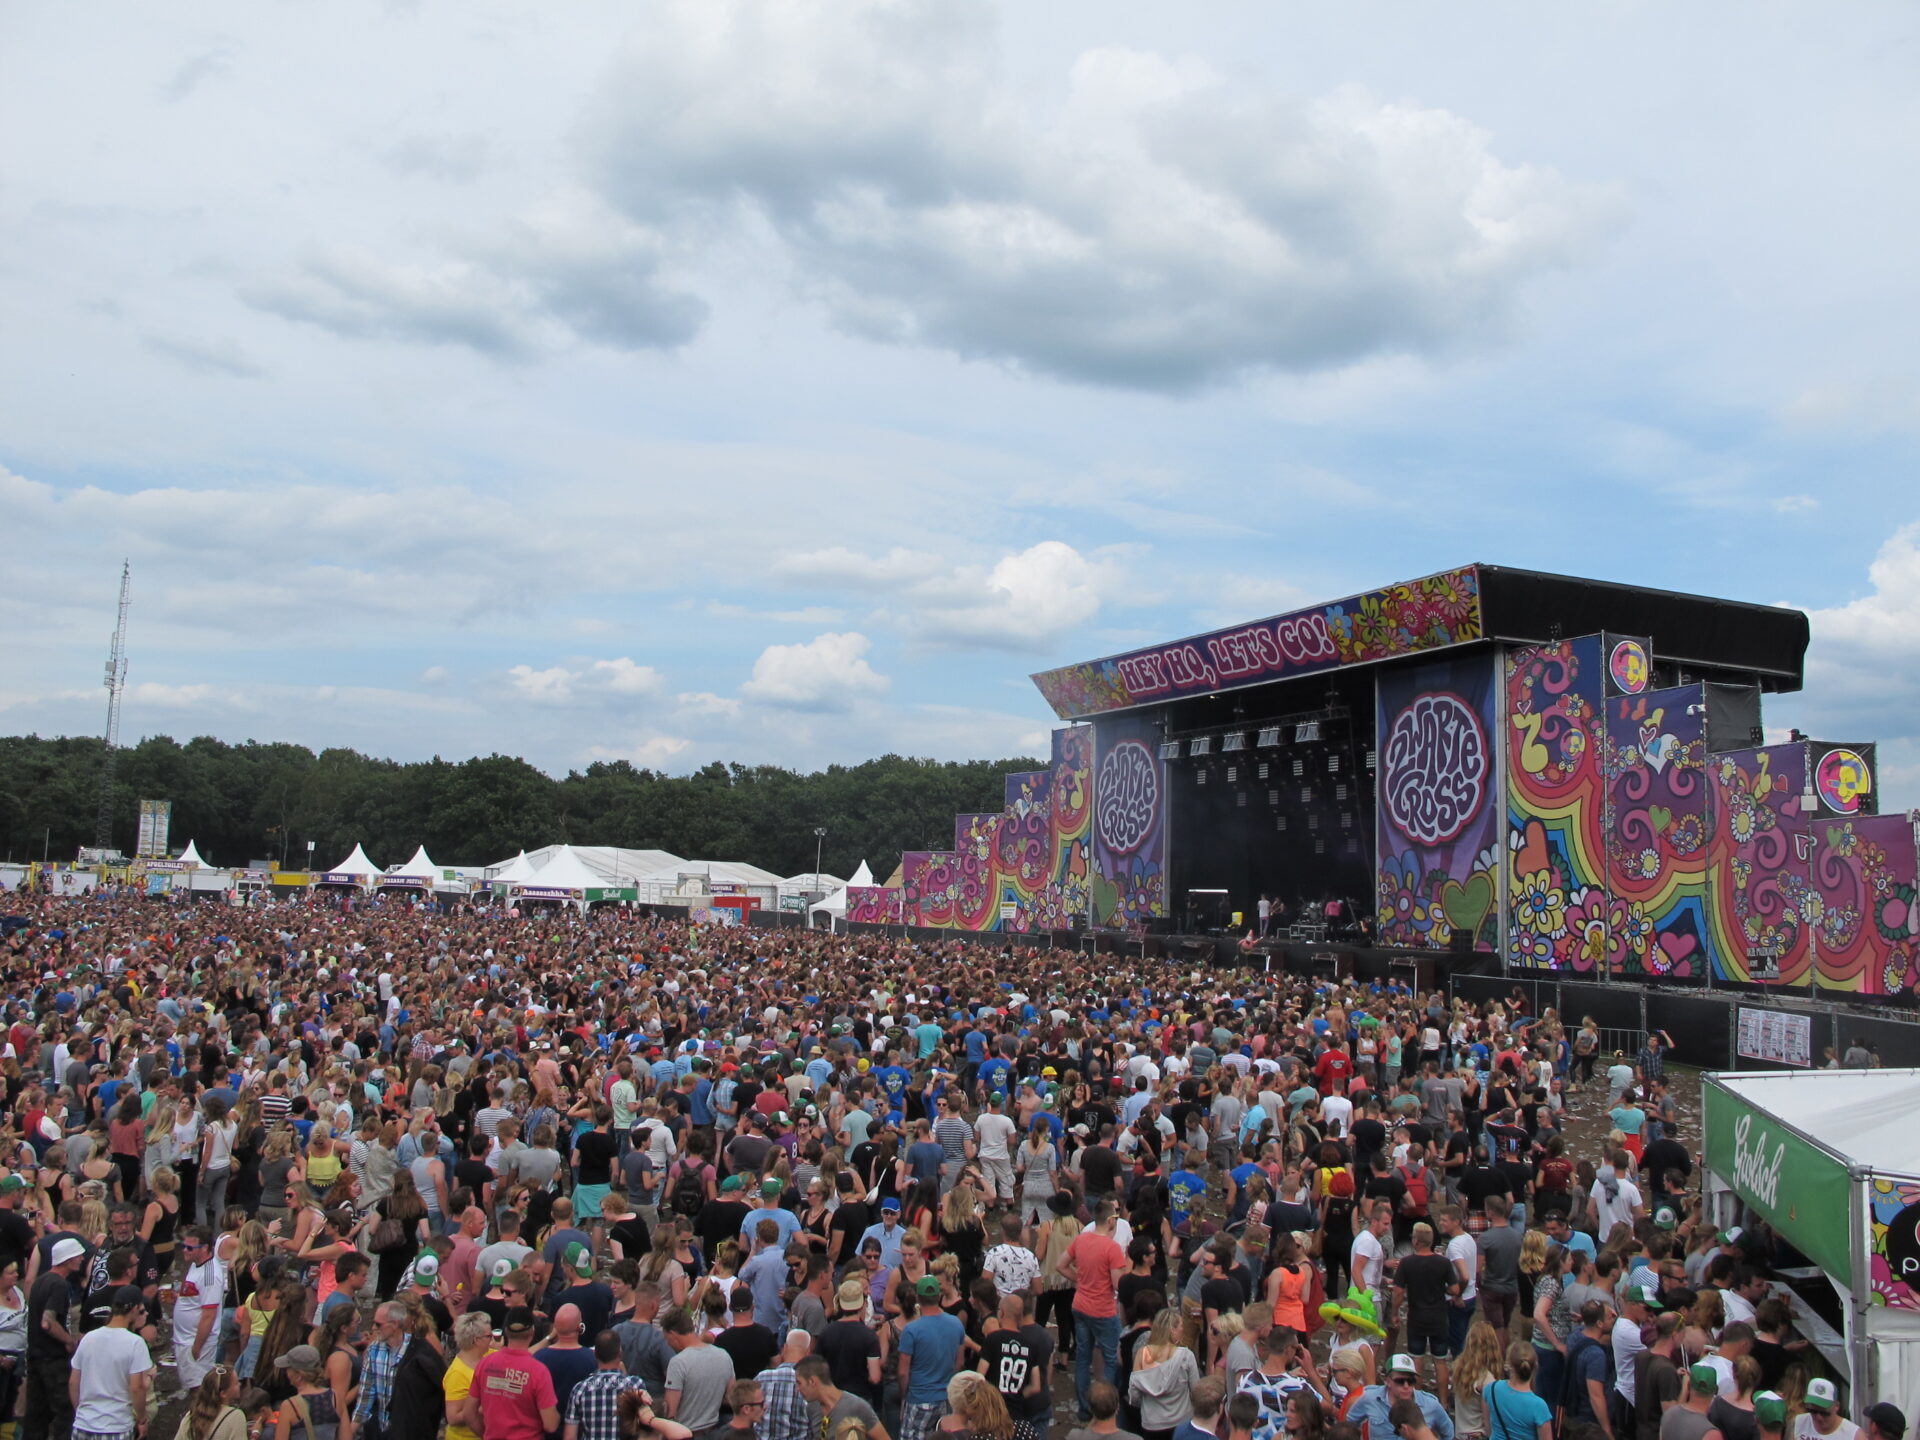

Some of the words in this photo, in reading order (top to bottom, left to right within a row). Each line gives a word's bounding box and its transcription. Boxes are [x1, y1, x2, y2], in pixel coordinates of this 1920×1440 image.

[1118, 653, 1168, 693] HEY
[1164, 645, 1216, 684] HO,
[1208, 628, 1280, 675] LET'S
[1277, 614, 1335, 660] GO!
[1100, 797, 1153, 851] CROSS
[1389, 770, 1478, 843] CROSS
[791, 1142, 798, 1159] 8
[1733, 1114, 1785, 1210] Grolsch
[998, 1356, 1028, 1393] 89
